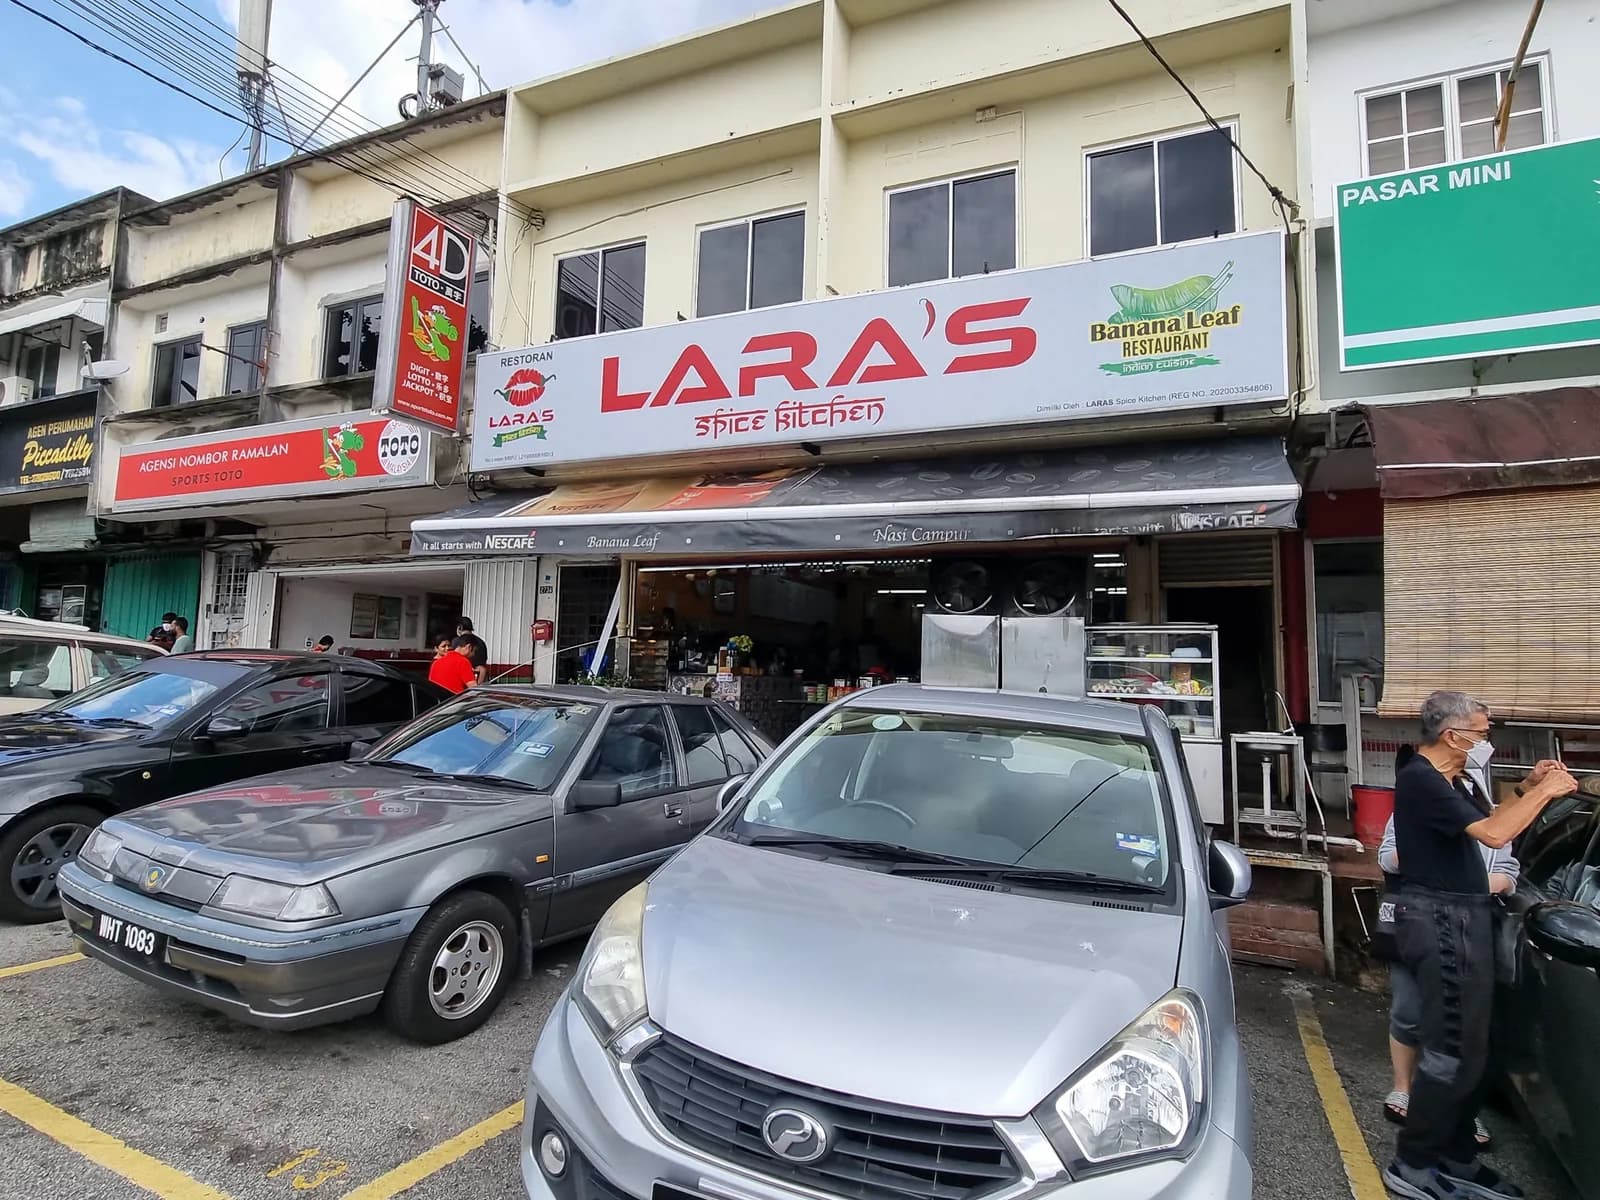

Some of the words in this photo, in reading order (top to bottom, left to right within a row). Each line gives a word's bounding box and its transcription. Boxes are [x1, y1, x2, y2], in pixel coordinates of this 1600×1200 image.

[1343, 175, 1439, 207] PASAR
[1449, 161, 1511, 189] MINI
[413, 224, 469, 280] 4D
[414, 269, 440, 290] TOTO
[1091, 318, 1182, 341] Banana
[1187, 305, 1240, 329] Leaf
[601, 297, 1037, 413] LARA'S
[1123, 332, 1209, 357] RESTAURANT
[410, 362, 430, 376] DIGIT
[500, 351, 553, 368] RESTORAN
[1122, 362, 1153, 373] indian
[402, 379, 434, 397] JACKPOT
[408, 371, 431, 386] LOTTO
[1086, 399, 1114, 408] LARAS
[1116, 397, 1137, 406] Spice
[1138, 394, 1167, 403] Kitchen
[48, 415, 94, 436] PERUMAHAN
[489, 409, 554, 428] LARA'S
[694, 408, 768, 440] spice
[774, 394, 886, 433] kitchen
[22, 433, 94, 471] Piccadilly
[381, 435, 419, 457] TOTO
[139, 455, 176, 473] AGENSI
[179, 450, 228, 469] NOMBOR
[231, 443, 289, 462] RAMALAN
[171, 473, 211, 488] SPORTS
[213, 469, 243, 484] TOTO
[586, 535, 630, 548] Banana
[632, 531, 661, 553] Leaf
[872, 523, 908, 543] Nasi
[430, 541, 440, 551] all
[441, 540, 464, 551] starts
[465, 540, 482, 550] with
[99, 914, 123, 943] WHT
[124, 924, 155, 955] 1083
